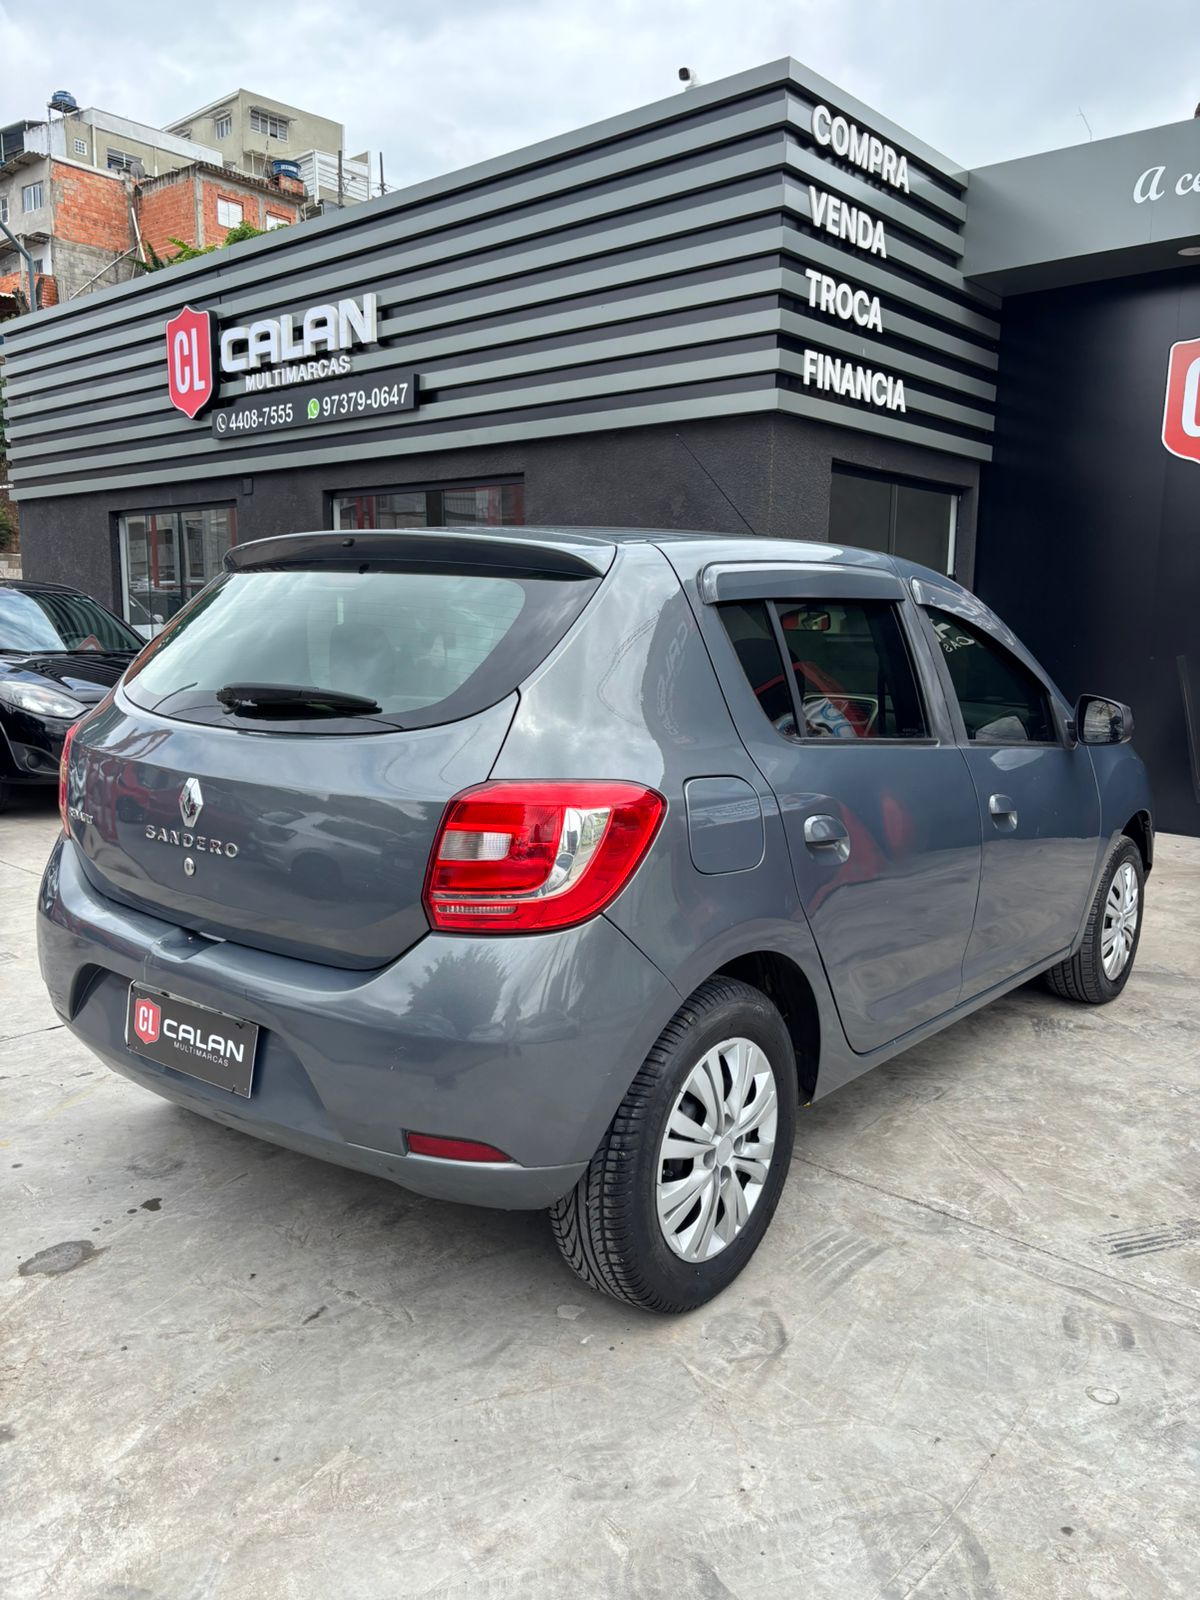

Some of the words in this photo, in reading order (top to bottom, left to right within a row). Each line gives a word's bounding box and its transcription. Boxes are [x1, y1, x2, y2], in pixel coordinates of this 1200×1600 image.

[811, 105, 910, 194] COMPRA
[809, 185, 887, 258] VENDA
[805, 268, 883, 333] TROCA
[174, 328, 206, 394] CL
[220, 293, 378, 373] CALAN
[245, 355, 352, 392] MULTIMARCAS
[803, 349, 907, 413] FINANCIA
[229, 403, 293, 431] 4408-7555
[322, 383, 409, 416] 97379-0647
[144, 825, 240, 858] SANDERO
[139, 1006, 155, 1035] CL
[163, 1019, 244, 1063] CALAN
[173, 1041, 229, 1067] MULTIMARCAS
